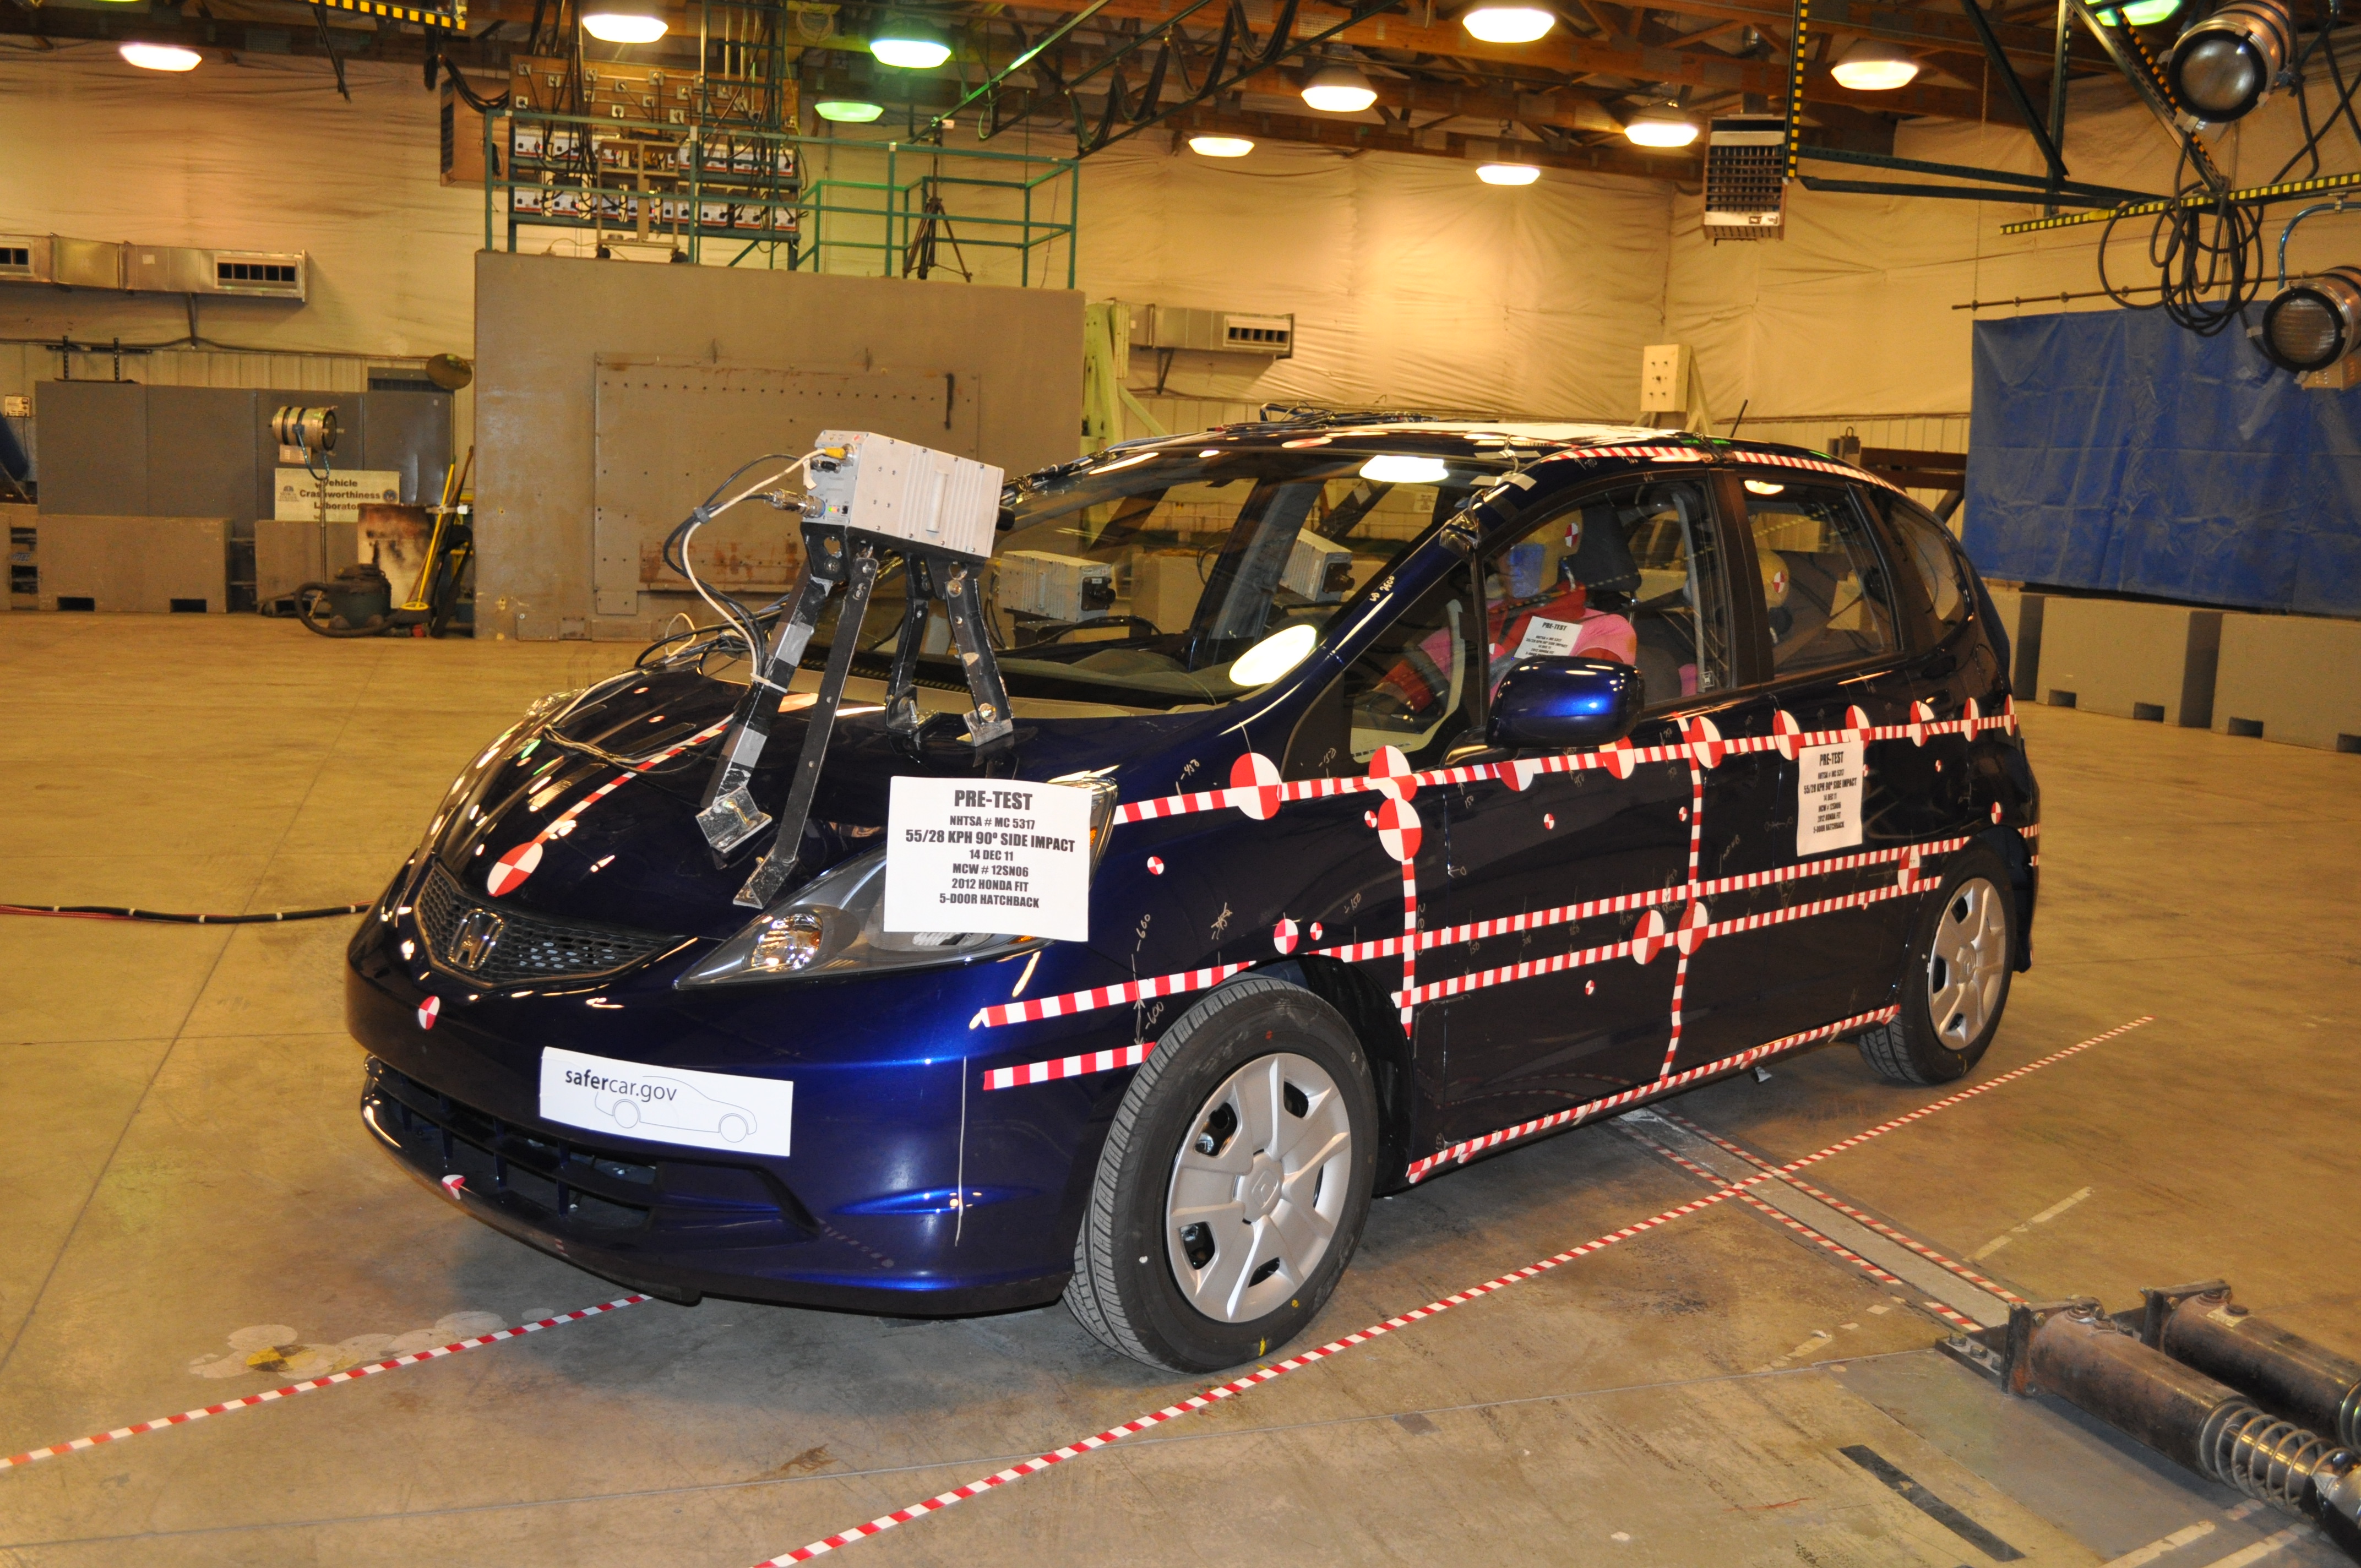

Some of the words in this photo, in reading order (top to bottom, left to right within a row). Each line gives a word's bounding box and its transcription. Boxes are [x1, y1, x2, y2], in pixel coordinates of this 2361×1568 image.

[1542, 622, 1567, 630] PRE-TEST
[1820, 752, 1843, 766] PRE-TEST
[1804, 785, 1816, 794] 55/28
[1842, 777, 1857, 787] IMPACT
[955, 790, 1032, 810] PRE-TEST
[950, 816, 982, 826] NHTSA
[984, 818, 992, 827] #
[995, 818, 1010, 827] MC
[1013, 819, 1035, 829] 5317
[906, 829, 944, 843] 55/28
[948, 831, 972, 843] KPH
[1000, 833, 1027, 847] SIDE
[1031, 835, 1075, 852] IMPACT
[970, 850, 980, 859] 14
[983, 850, 1002, 861] DEC
[1004, 851, 1013, 861] 11
[953, 863, 979, 874] MCW
[981, 865, 988, 875] #
[952, 878, 976, 889] 2012
[978, 879, 1012, 891] HONDA
[1015, 881, 1029, 892] FIT
[940, 894, 977, 904] 5-DOOR
[980, 895, 1039, 908] HATCHBACK
[564, 1068, 677, 1103] safercar.gov
